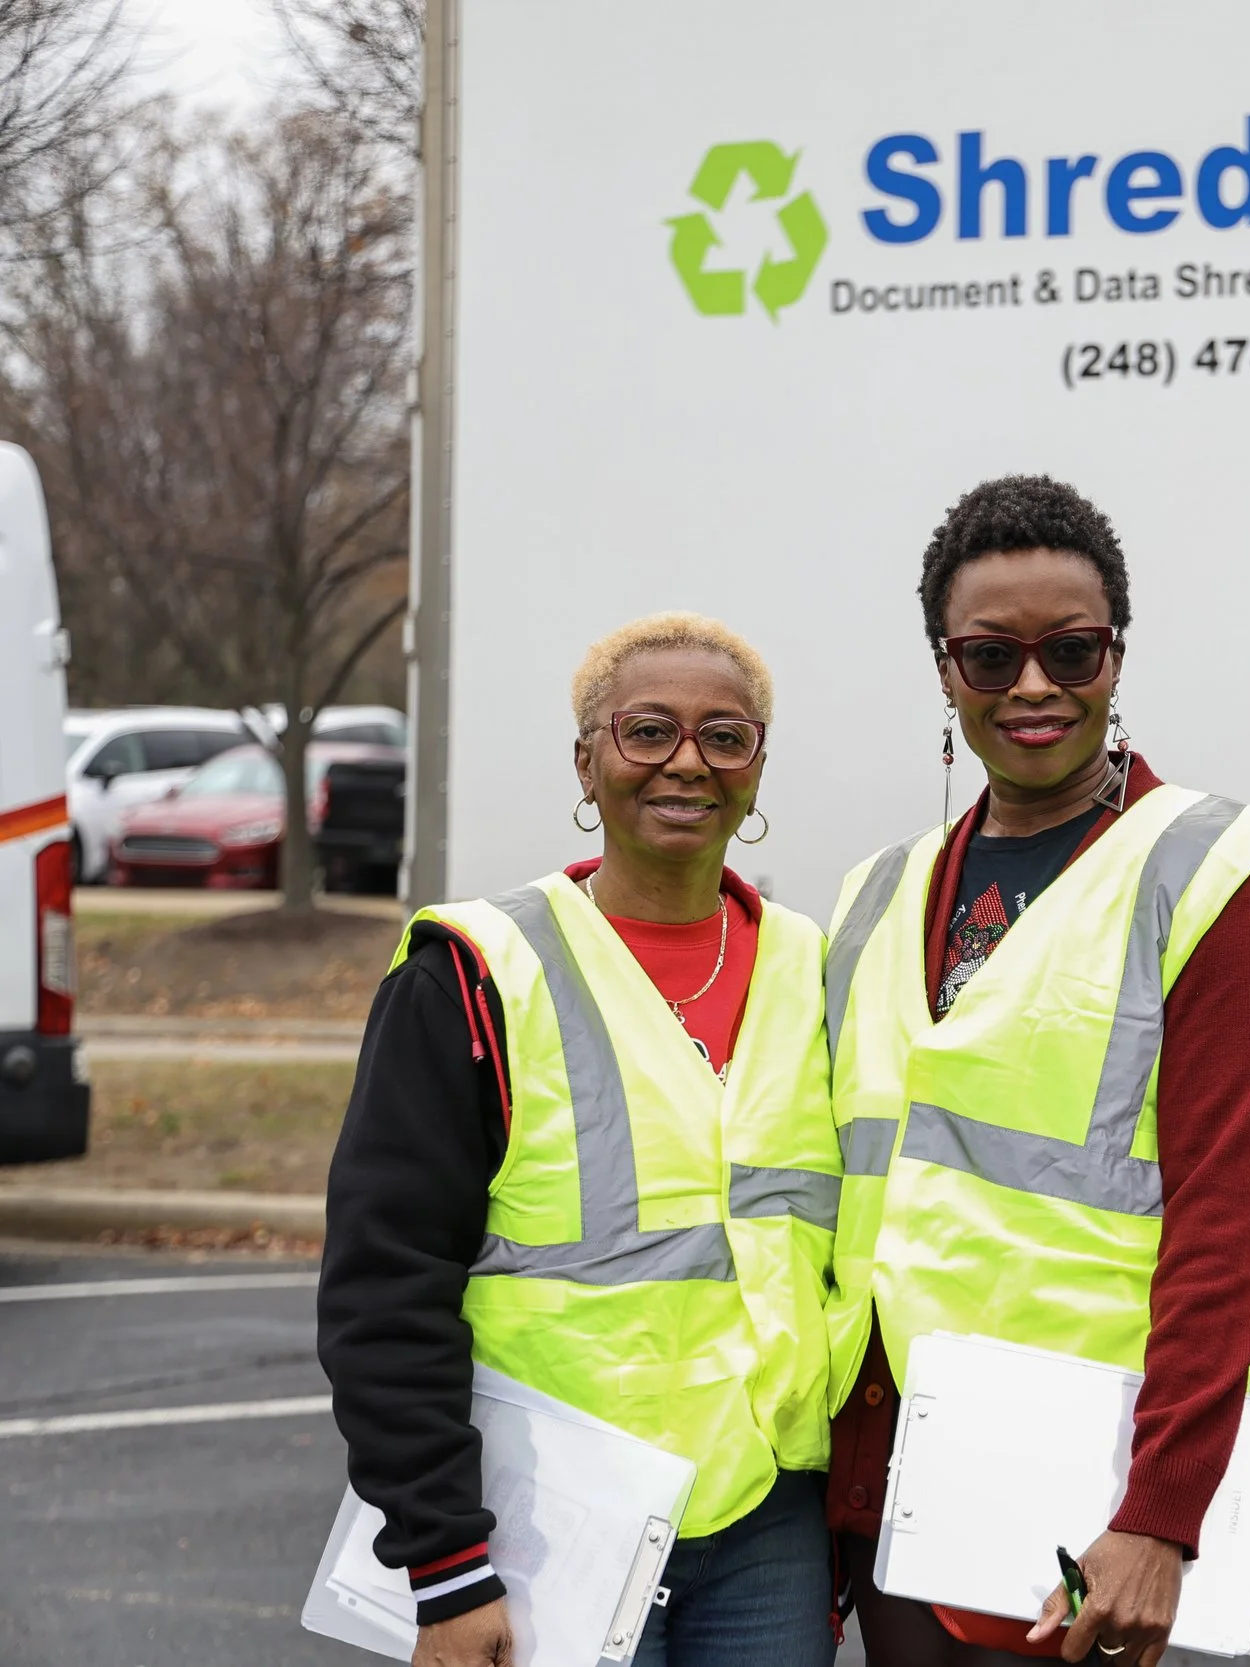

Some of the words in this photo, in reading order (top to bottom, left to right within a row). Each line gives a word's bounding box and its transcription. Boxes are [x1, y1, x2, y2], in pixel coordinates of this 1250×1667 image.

[831, 270, 1020, 314] Document
[1034, 270, 1059, 304] &
[1075, 264, 1161, 303] Data
[1062, 342, 1176, 388] (248)
